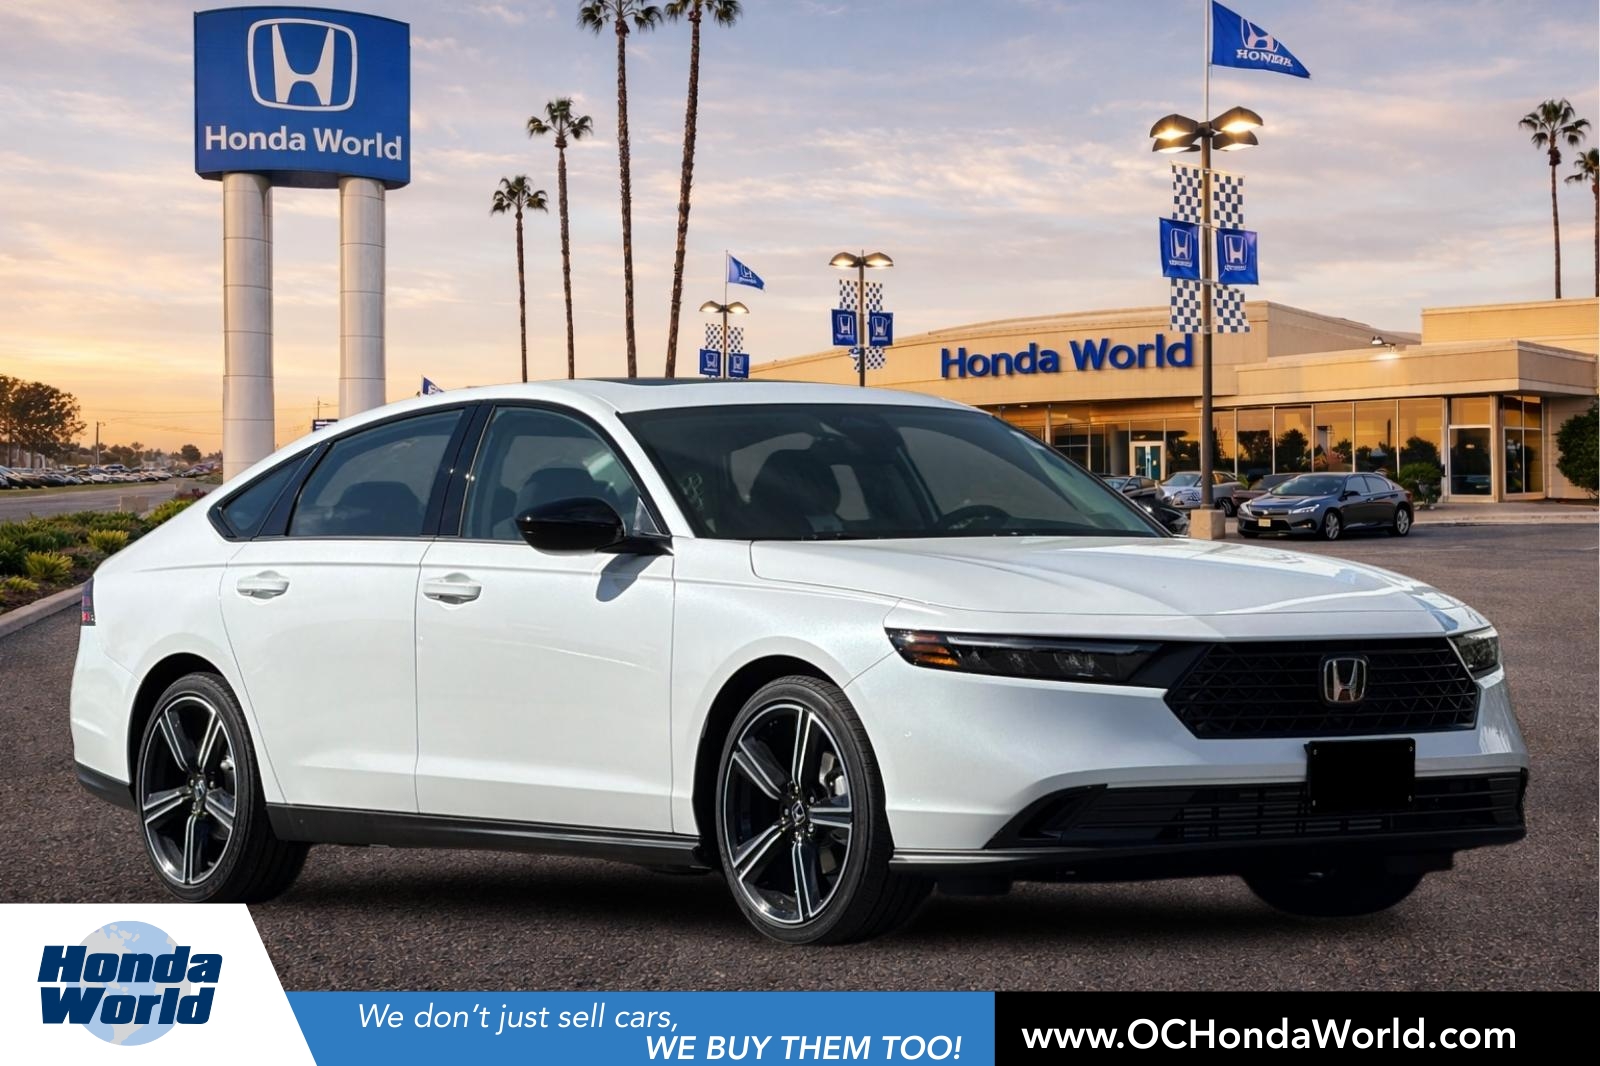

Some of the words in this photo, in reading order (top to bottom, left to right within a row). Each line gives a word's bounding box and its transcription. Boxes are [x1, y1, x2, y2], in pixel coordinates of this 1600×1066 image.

[205, 125, 306, 151] Honda
[313, 127, 402, 161] World
[941, 342, 1061, 378] Honda
[1069, 333, 1195, 371] World
